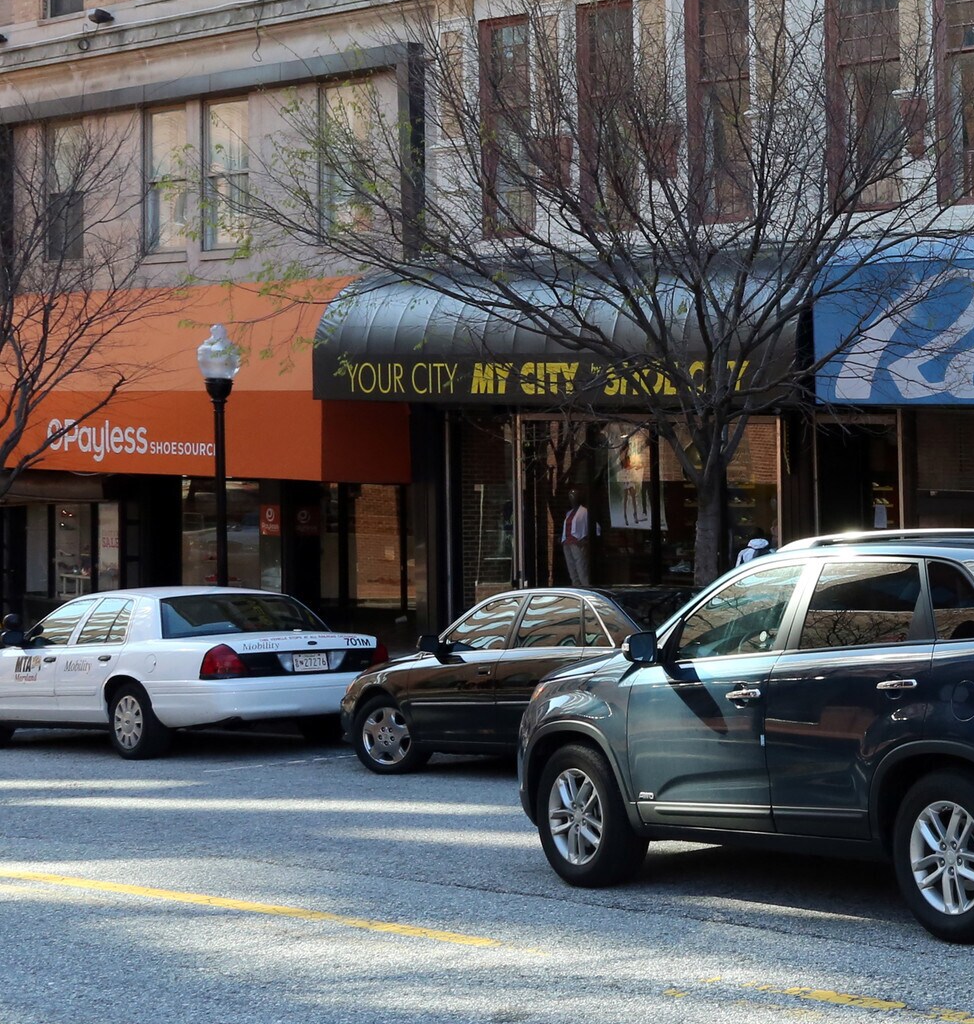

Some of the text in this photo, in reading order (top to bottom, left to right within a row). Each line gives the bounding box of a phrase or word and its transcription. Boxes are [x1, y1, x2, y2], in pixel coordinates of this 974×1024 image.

[346, 362, 405, 394] YOUR
[411, 362, 458, 394] CITY
[471, 362, 514, 395] MY
[520, 361, 580, 395] CITY
[64, 418, 148, 462] Payless
[242, 641, 280, 651] Mobility
[343, 637, 371, 647] 701M
[15, 656, 33, 672] MTA
[63, 659, 92, 675] Mobility
